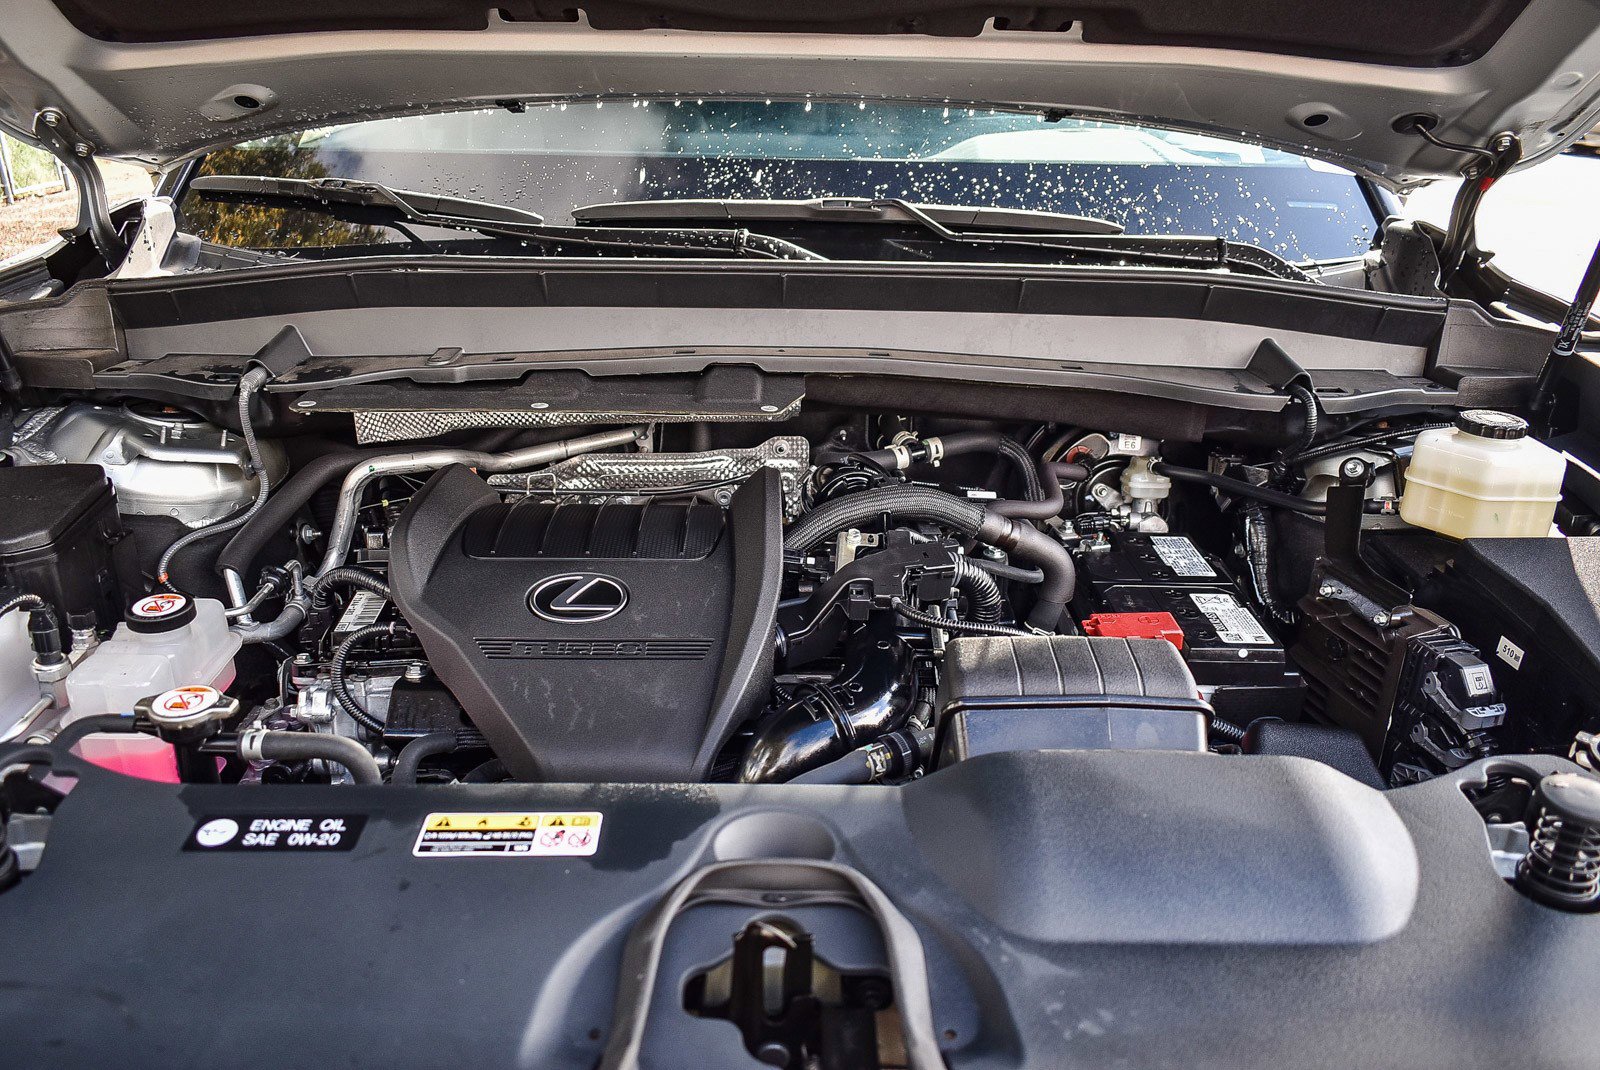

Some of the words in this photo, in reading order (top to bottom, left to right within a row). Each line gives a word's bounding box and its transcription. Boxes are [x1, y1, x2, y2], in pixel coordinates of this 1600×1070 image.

[515, 641, 642, 656] TURBO
[1502, 644, 1515, 658] 510
[249, 818, 314, 832] ENGINE
[319, 818, 347, 832] OIL
[241, 832, 280, 847] SAE
[286, 832, 342, 847] 0W-20
